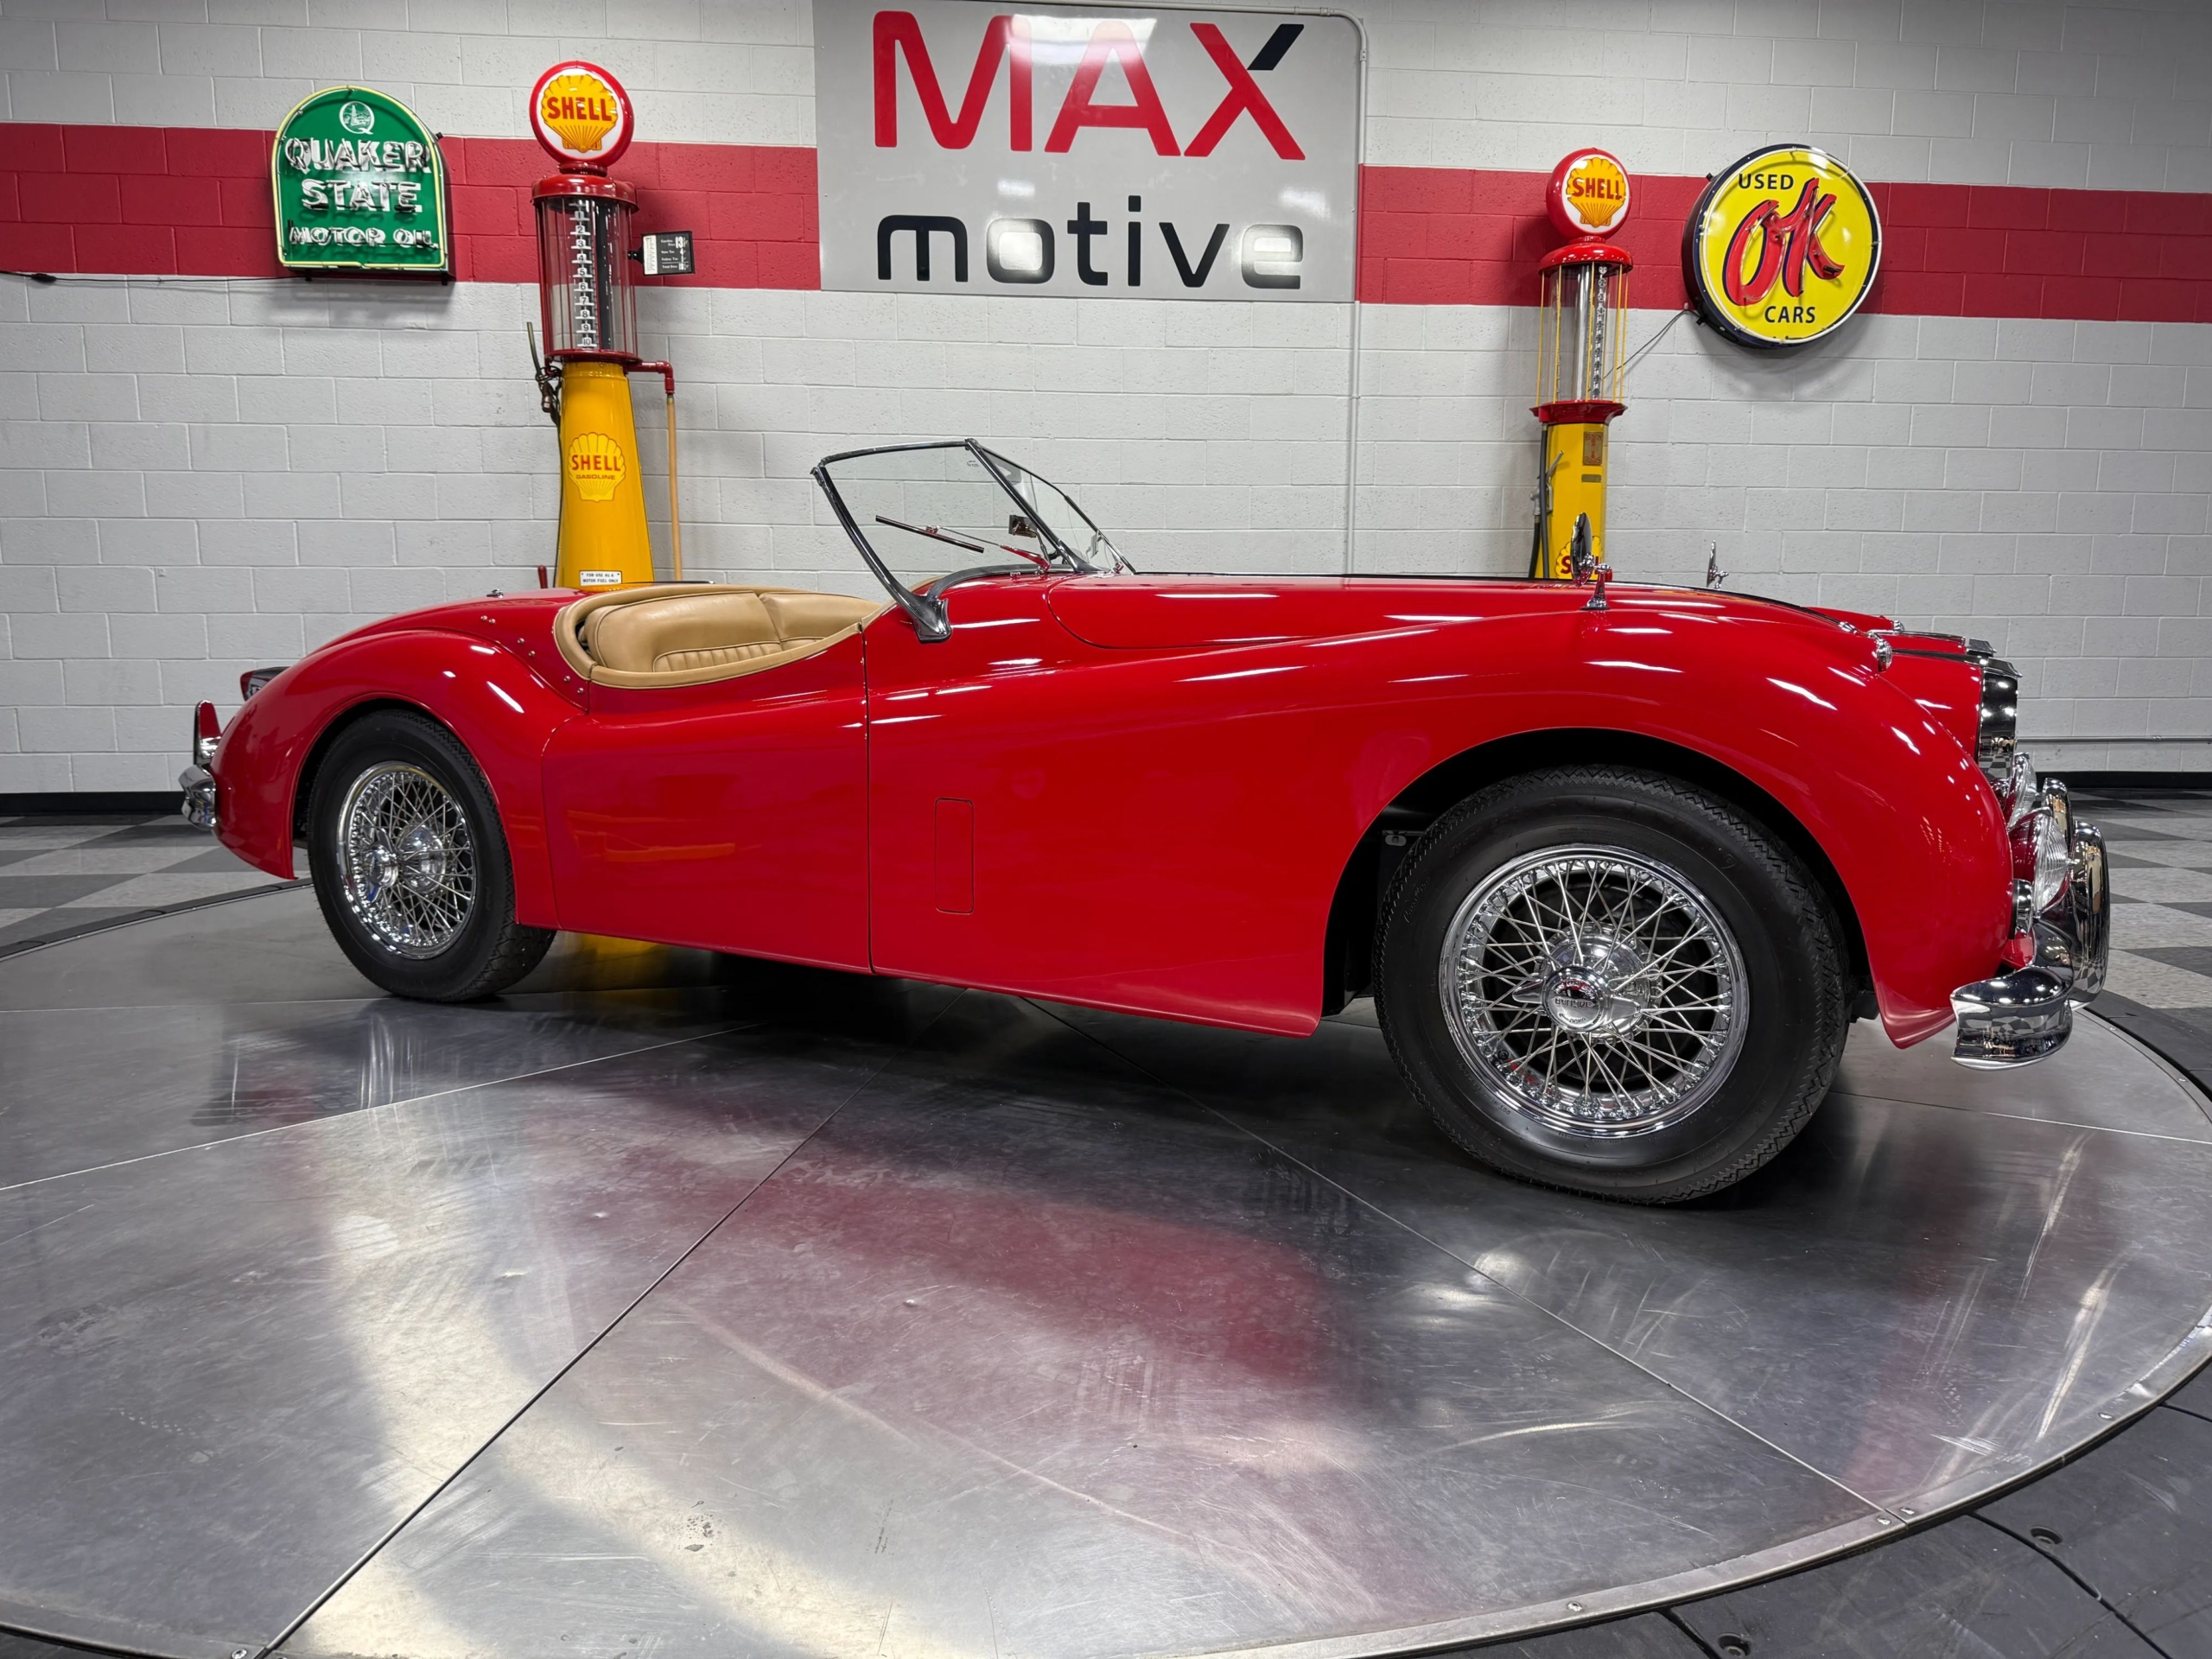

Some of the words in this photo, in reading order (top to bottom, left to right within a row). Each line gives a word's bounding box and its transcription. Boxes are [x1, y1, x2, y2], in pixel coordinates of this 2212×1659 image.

[872, 10, 1306, 160] MAX
[546, 96, 612, 122] SHELL
[285, 137, 432, 175] QUAKER
[1571, 177, 1623, 200] SHELL
[1738, 173, 1795, 190] USED
[302, 178, 423, 213] STATE
[289, 226, 386, 247] MOTOR
[392, 228, 438, 250] OIL
[876, 194, 1305, 290] motive
[1764, 305, 1816, 324] CARS
[571, 454, 621, 472] SHELL
